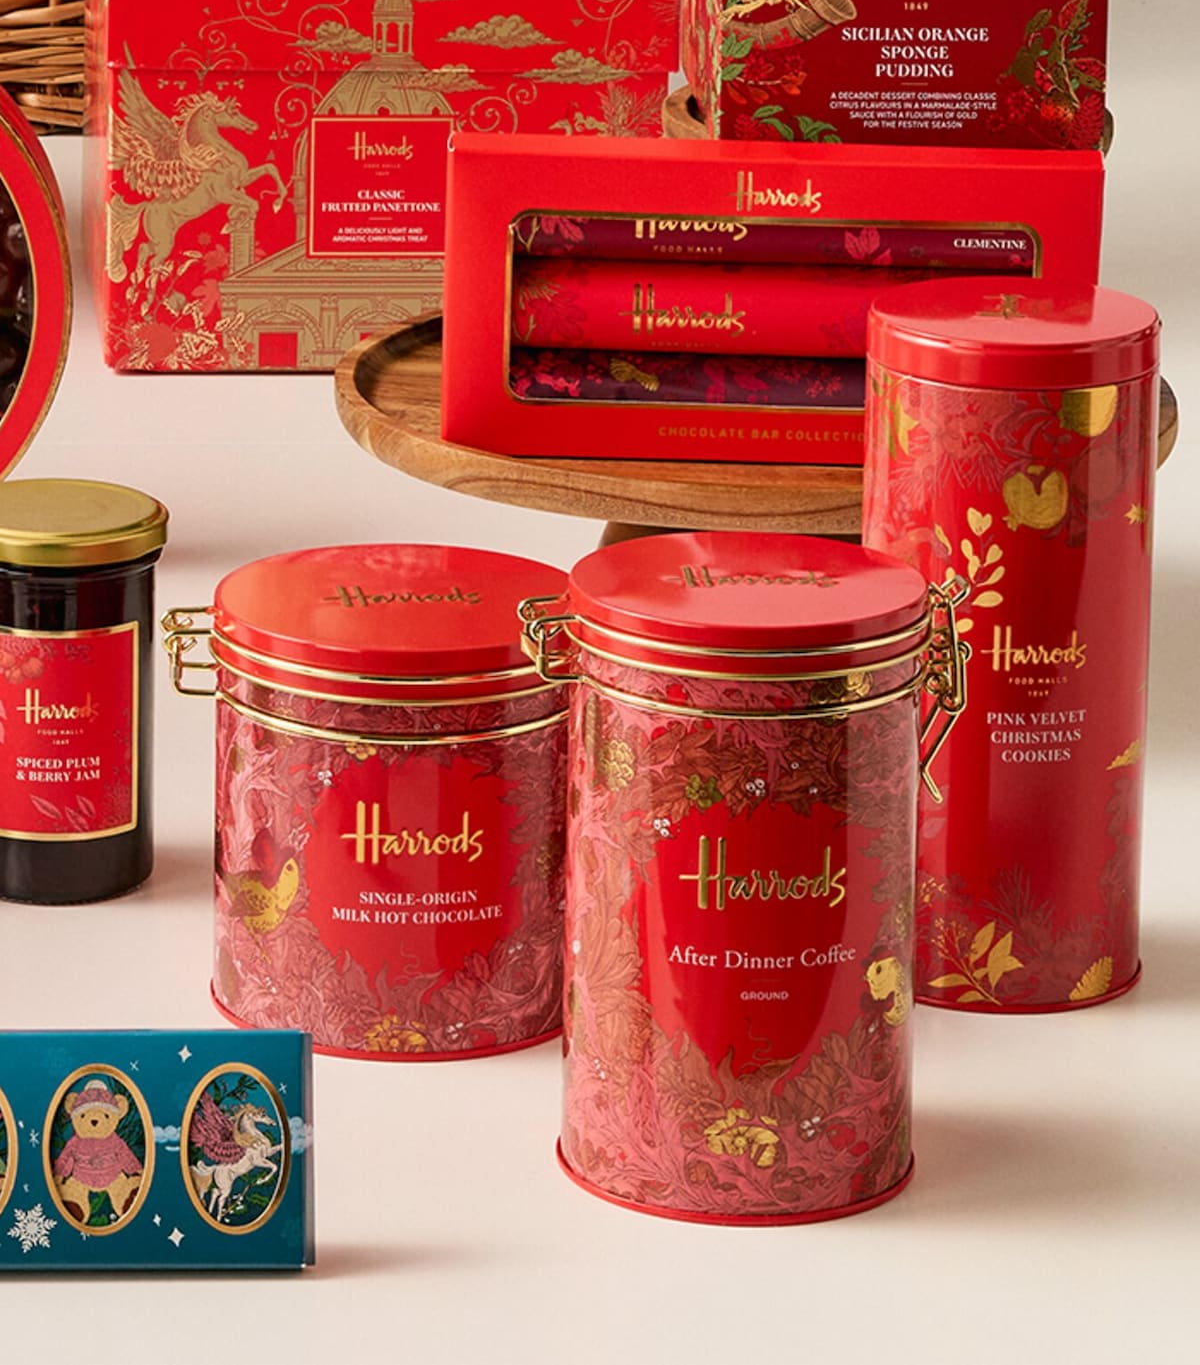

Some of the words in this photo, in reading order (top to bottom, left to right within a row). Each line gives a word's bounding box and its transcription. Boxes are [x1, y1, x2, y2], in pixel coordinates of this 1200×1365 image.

[904, 2, 929, 11] 1849
[841, 27, 914, 42] SICILIAN
[918, 27, 989, 42] ORANGE
[880, 45, 949, 60] SPONGE
[875, 63, 954, 78] PUDDING
[830, 92, 837, 100] A
[838, 92, 879, 100] DECADENT
[880, 92, 916, 100] DESSERT
[917, 92, 962, 100] COMBINING
[963, 92, 997, 100] CLASSIC
[830, 102, 859, 110] CITRUS
[860, 102, 902, 110] FLAVOURS
[903, 102, 912, 110] IN
[913, 102, 920, 110] A
[921, 102, 997, 111] MARMALADE-STYLE
[850, 111, 875, 119] SAUCE
[876, 111, 897, 119] WITH
[898, 111, 904, 119] A
[905, 111, 943, 119] FLOURISH
[944, 111, 955, 119] OF
[956, 111, 978, 119] GOLD
[863, 121, 880, 129] FOR
[881, 121, 897, 129] THE
[898, 121, 930, 129] FESTIVE
[931, 121, 963, 129] SEASON
[347, 131, 414, 161] Harrods
[357, 189, 406, 200] CLASSIC
[727, 171, 822, 213] Harrods
[321, 202, 371, 213] FRUITED
[372, 202, 441, 213] PANETTONE
[653, 245, 683, 254] FOOD
[953, 238, 1027, 250] CLEMENTINE
[618, 283, 746, 338] Harrods
[658, 427, 745, 438] CHOCOLATE
[751, 429, 779, 439] BAR
[665, 565, 840, 588] Harrods
[323, 585, 481, 608] Harrods
[980, 625, 1087, 672] Harrods
[1008, 677, 1034, 685] FOOD
[16, 688, 100, 725] Harrods
[986, 712, 1027, 726] PINK
[1030, 709, 1087, 726] VELVET
[990, 729, 1082, 745] CHRISTMAS
[15, 756, 63, 769] SPICED
[65, 755, 101, 769] PLUM
[1001, 748, 1072, 763] COOKIES
[15, 770, 26, 781] &
[28, 771, 72, 782] BERRY
[73, 769, 101, 782] JAM
[340, 800, 484, 865] Harrods
[679, 835, 847, 911] Harrods
[359, 890, 478, 907] SINGLE-ORIGIN
[332, 906, 372, 923] MILK
[373, 910, 410, 924] HOT
[412, 904, 503, 924] CHOCOLATE
[668, 944, 718, 967] After
[724, 950, 795, 969] Dinner
[800, 942, 857, 967] Coffee
[739, 990, 790, 1001] GROUND
